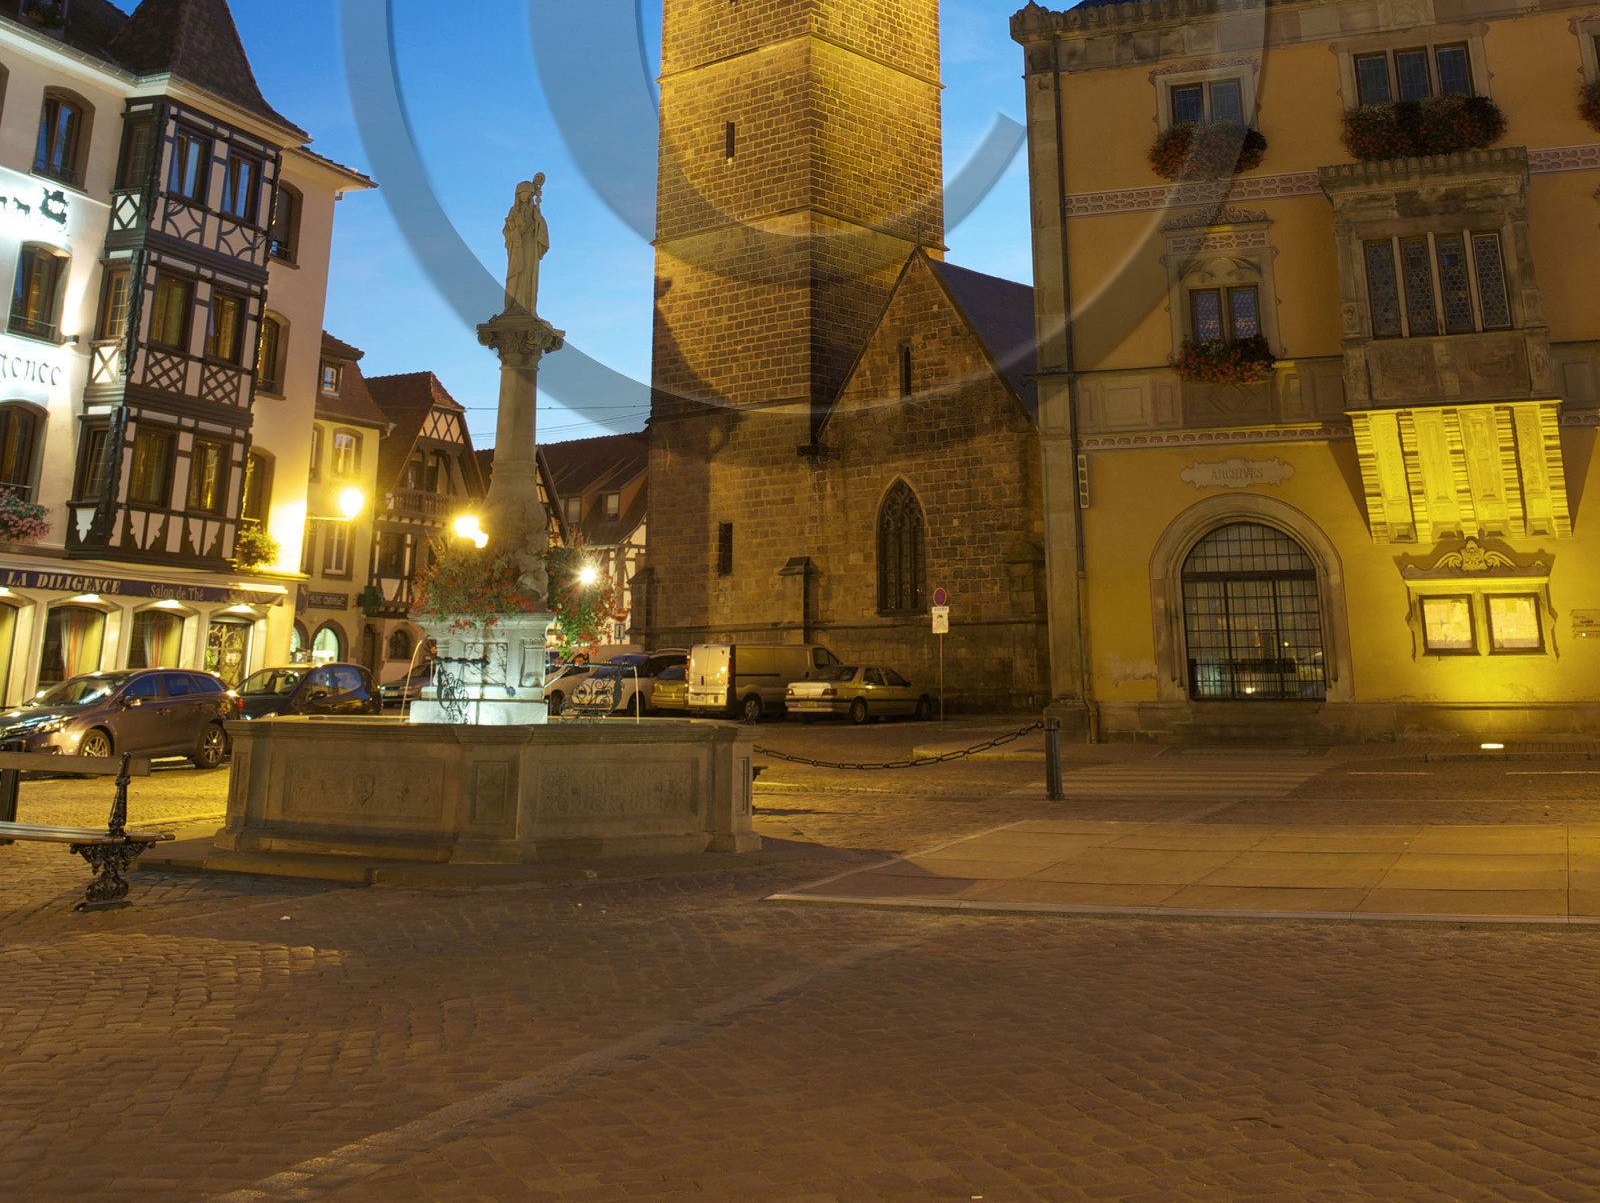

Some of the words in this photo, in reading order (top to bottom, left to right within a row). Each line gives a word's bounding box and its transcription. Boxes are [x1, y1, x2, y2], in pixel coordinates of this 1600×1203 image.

[1210, 467, 1264, 480] ARCHIVES
[6, 571, 27, 586] LA
[36, 573, 121, 594] DILIGENCE
[150, 584, 174, 598] Salon
[176, 588, 186, 598] de
